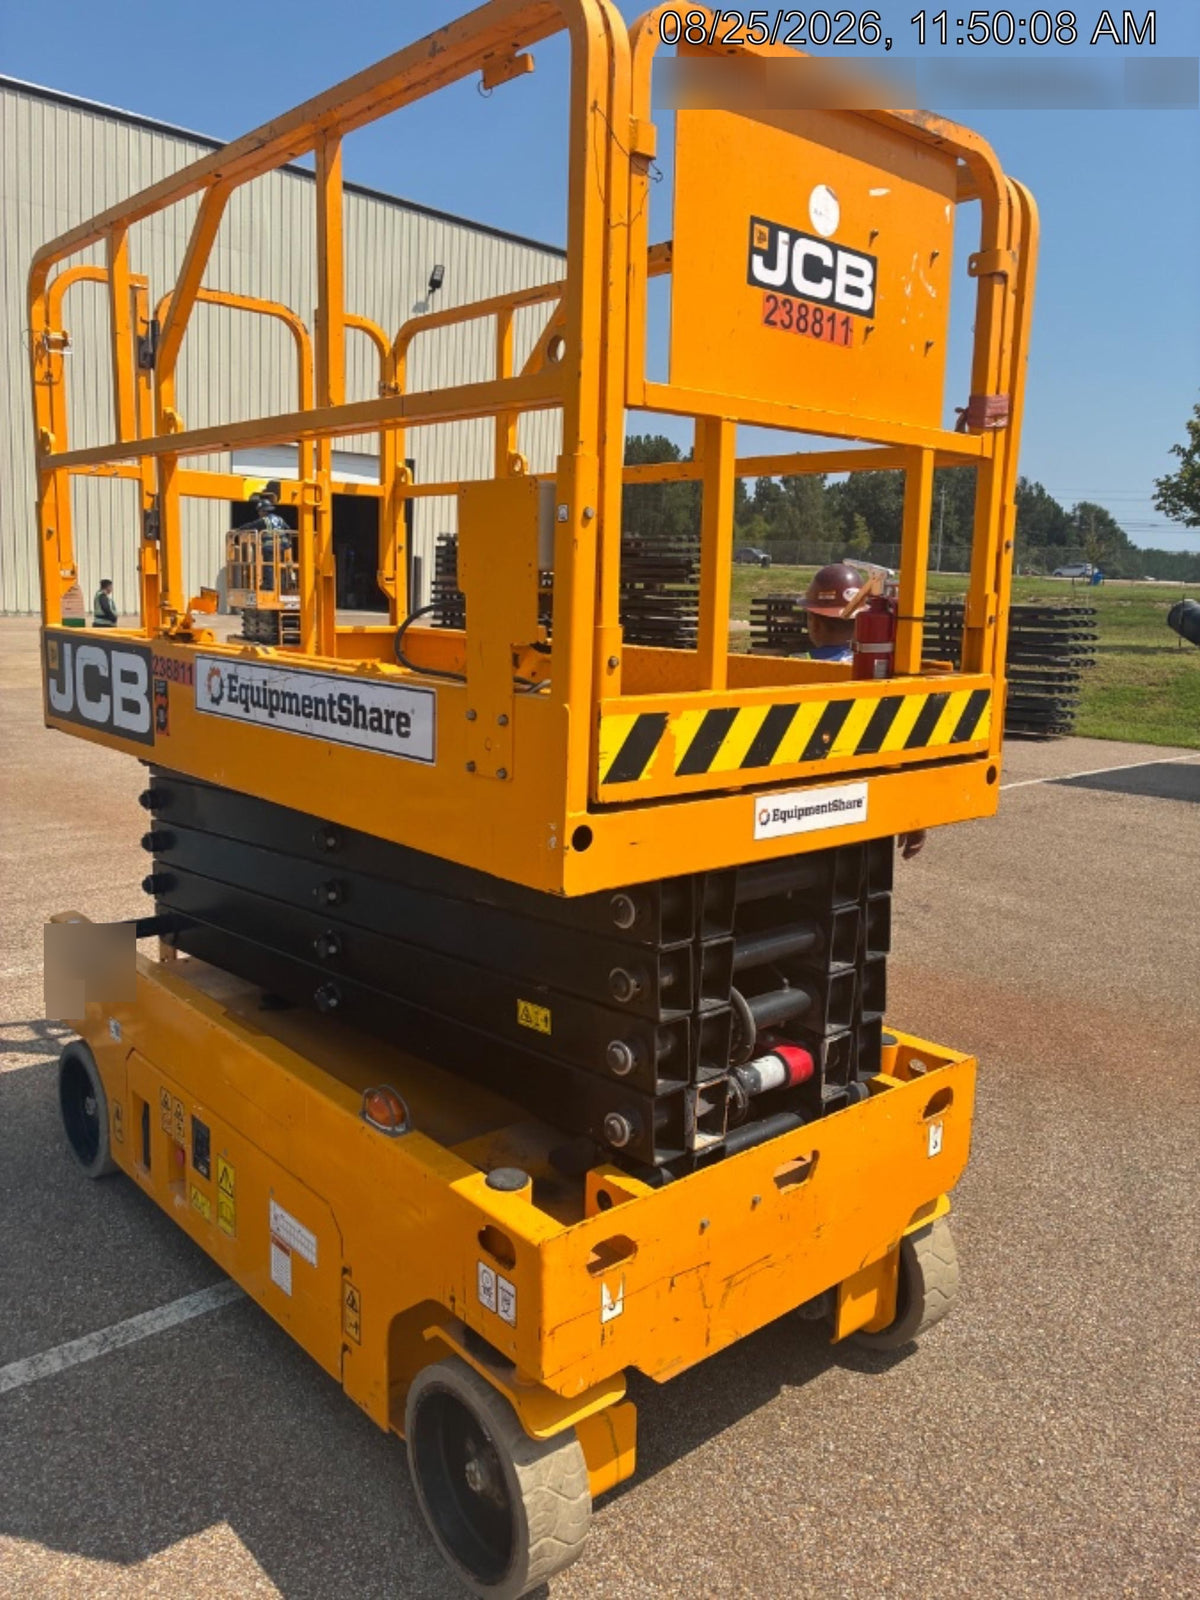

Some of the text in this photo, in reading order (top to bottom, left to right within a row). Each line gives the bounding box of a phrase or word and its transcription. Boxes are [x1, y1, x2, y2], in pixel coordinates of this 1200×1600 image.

[752, 230, 874, 311] JCB
[763, 294, 852, 345] 238811
[49, 642, 151, 733] JCB
[226, 673, 412, 739] EquipmentShare
[771, 798, 863, 823] EquipmentShare
